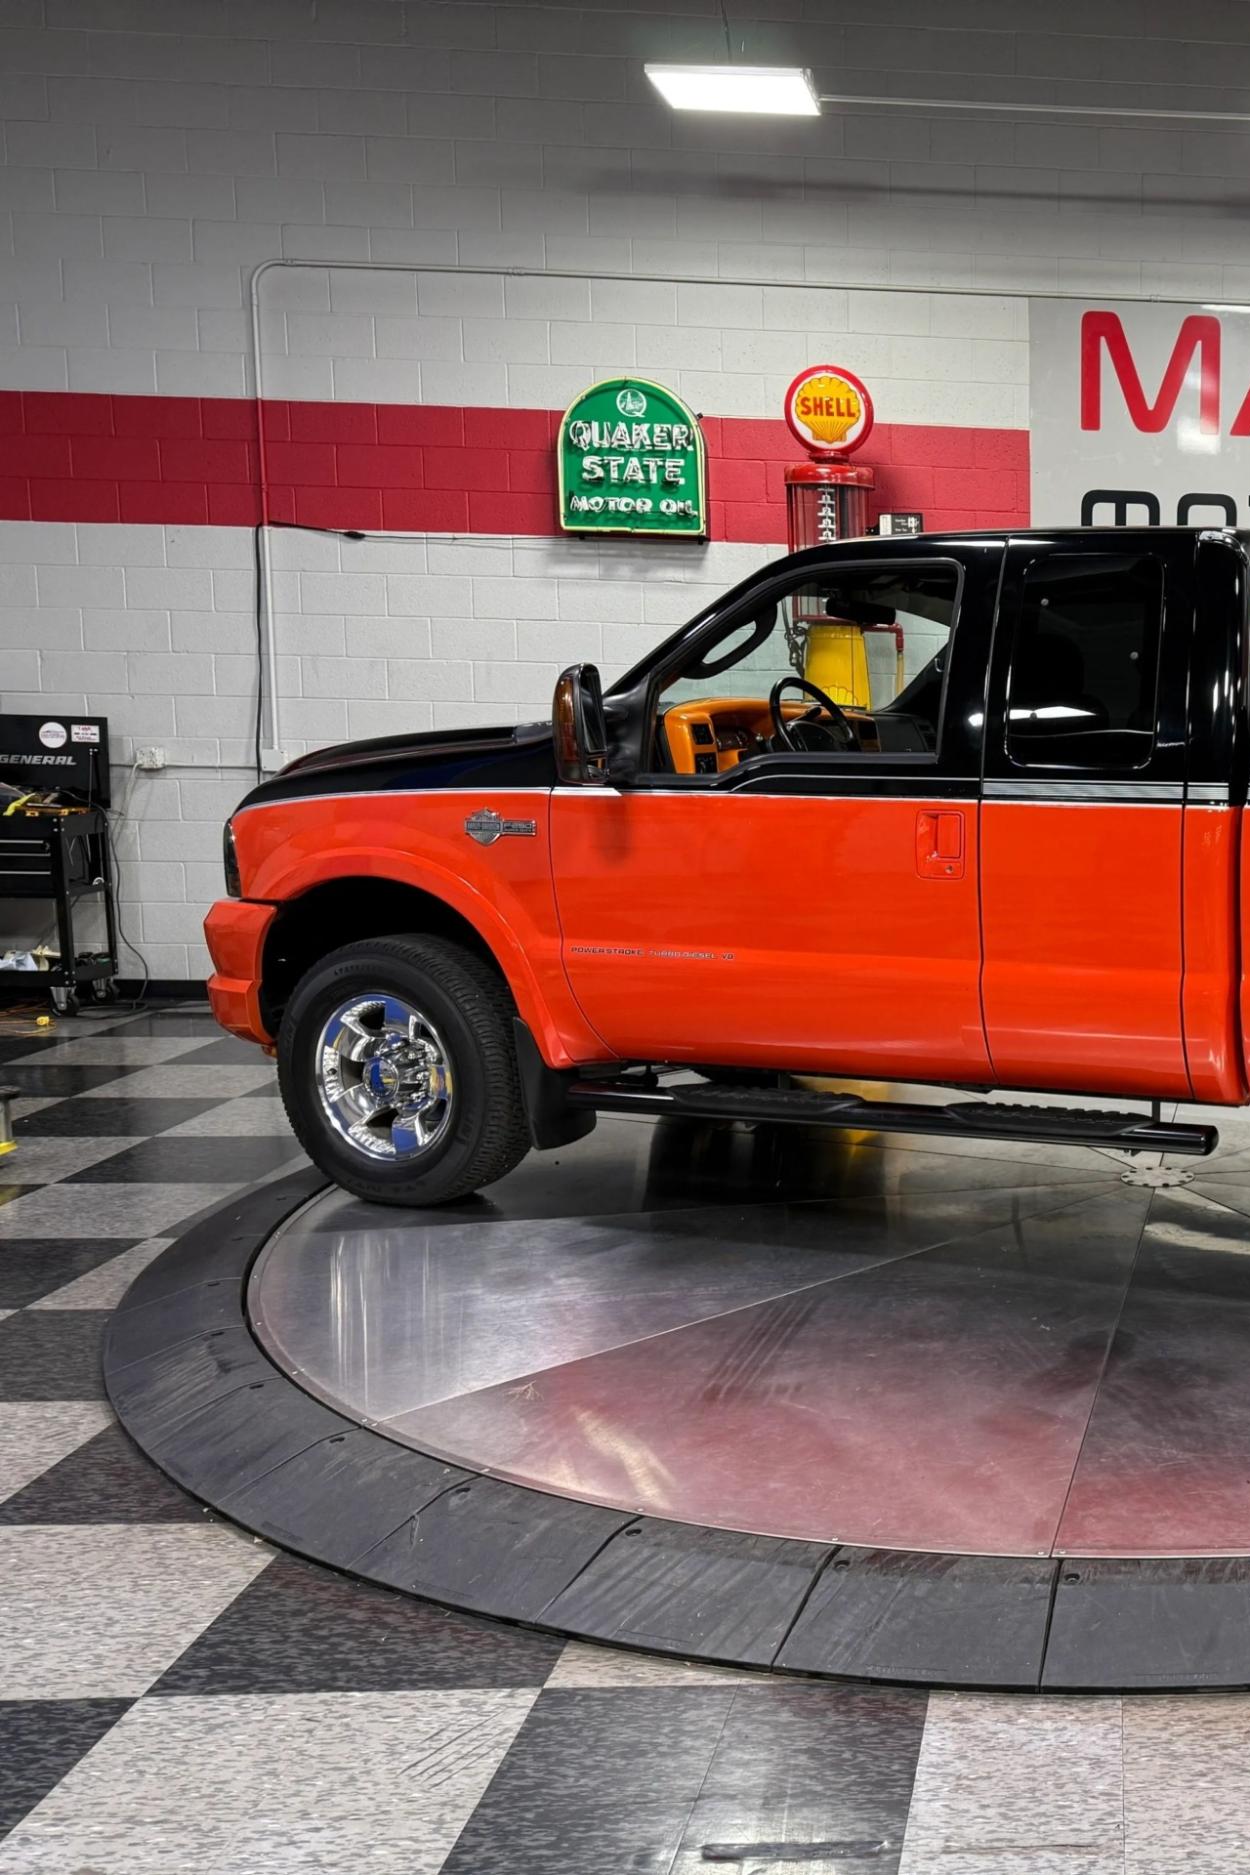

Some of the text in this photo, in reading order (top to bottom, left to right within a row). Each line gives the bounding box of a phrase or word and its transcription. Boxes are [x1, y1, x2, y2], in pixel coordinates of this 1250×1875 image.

[800, 396, 856, 418] SHELL
[569, 420, 694, 450] QUAKER
[582, 455, 686, 485] STATE
[570, 495, 654, 513] MOTOR
[0, 754, 77, 766] GENERAL
